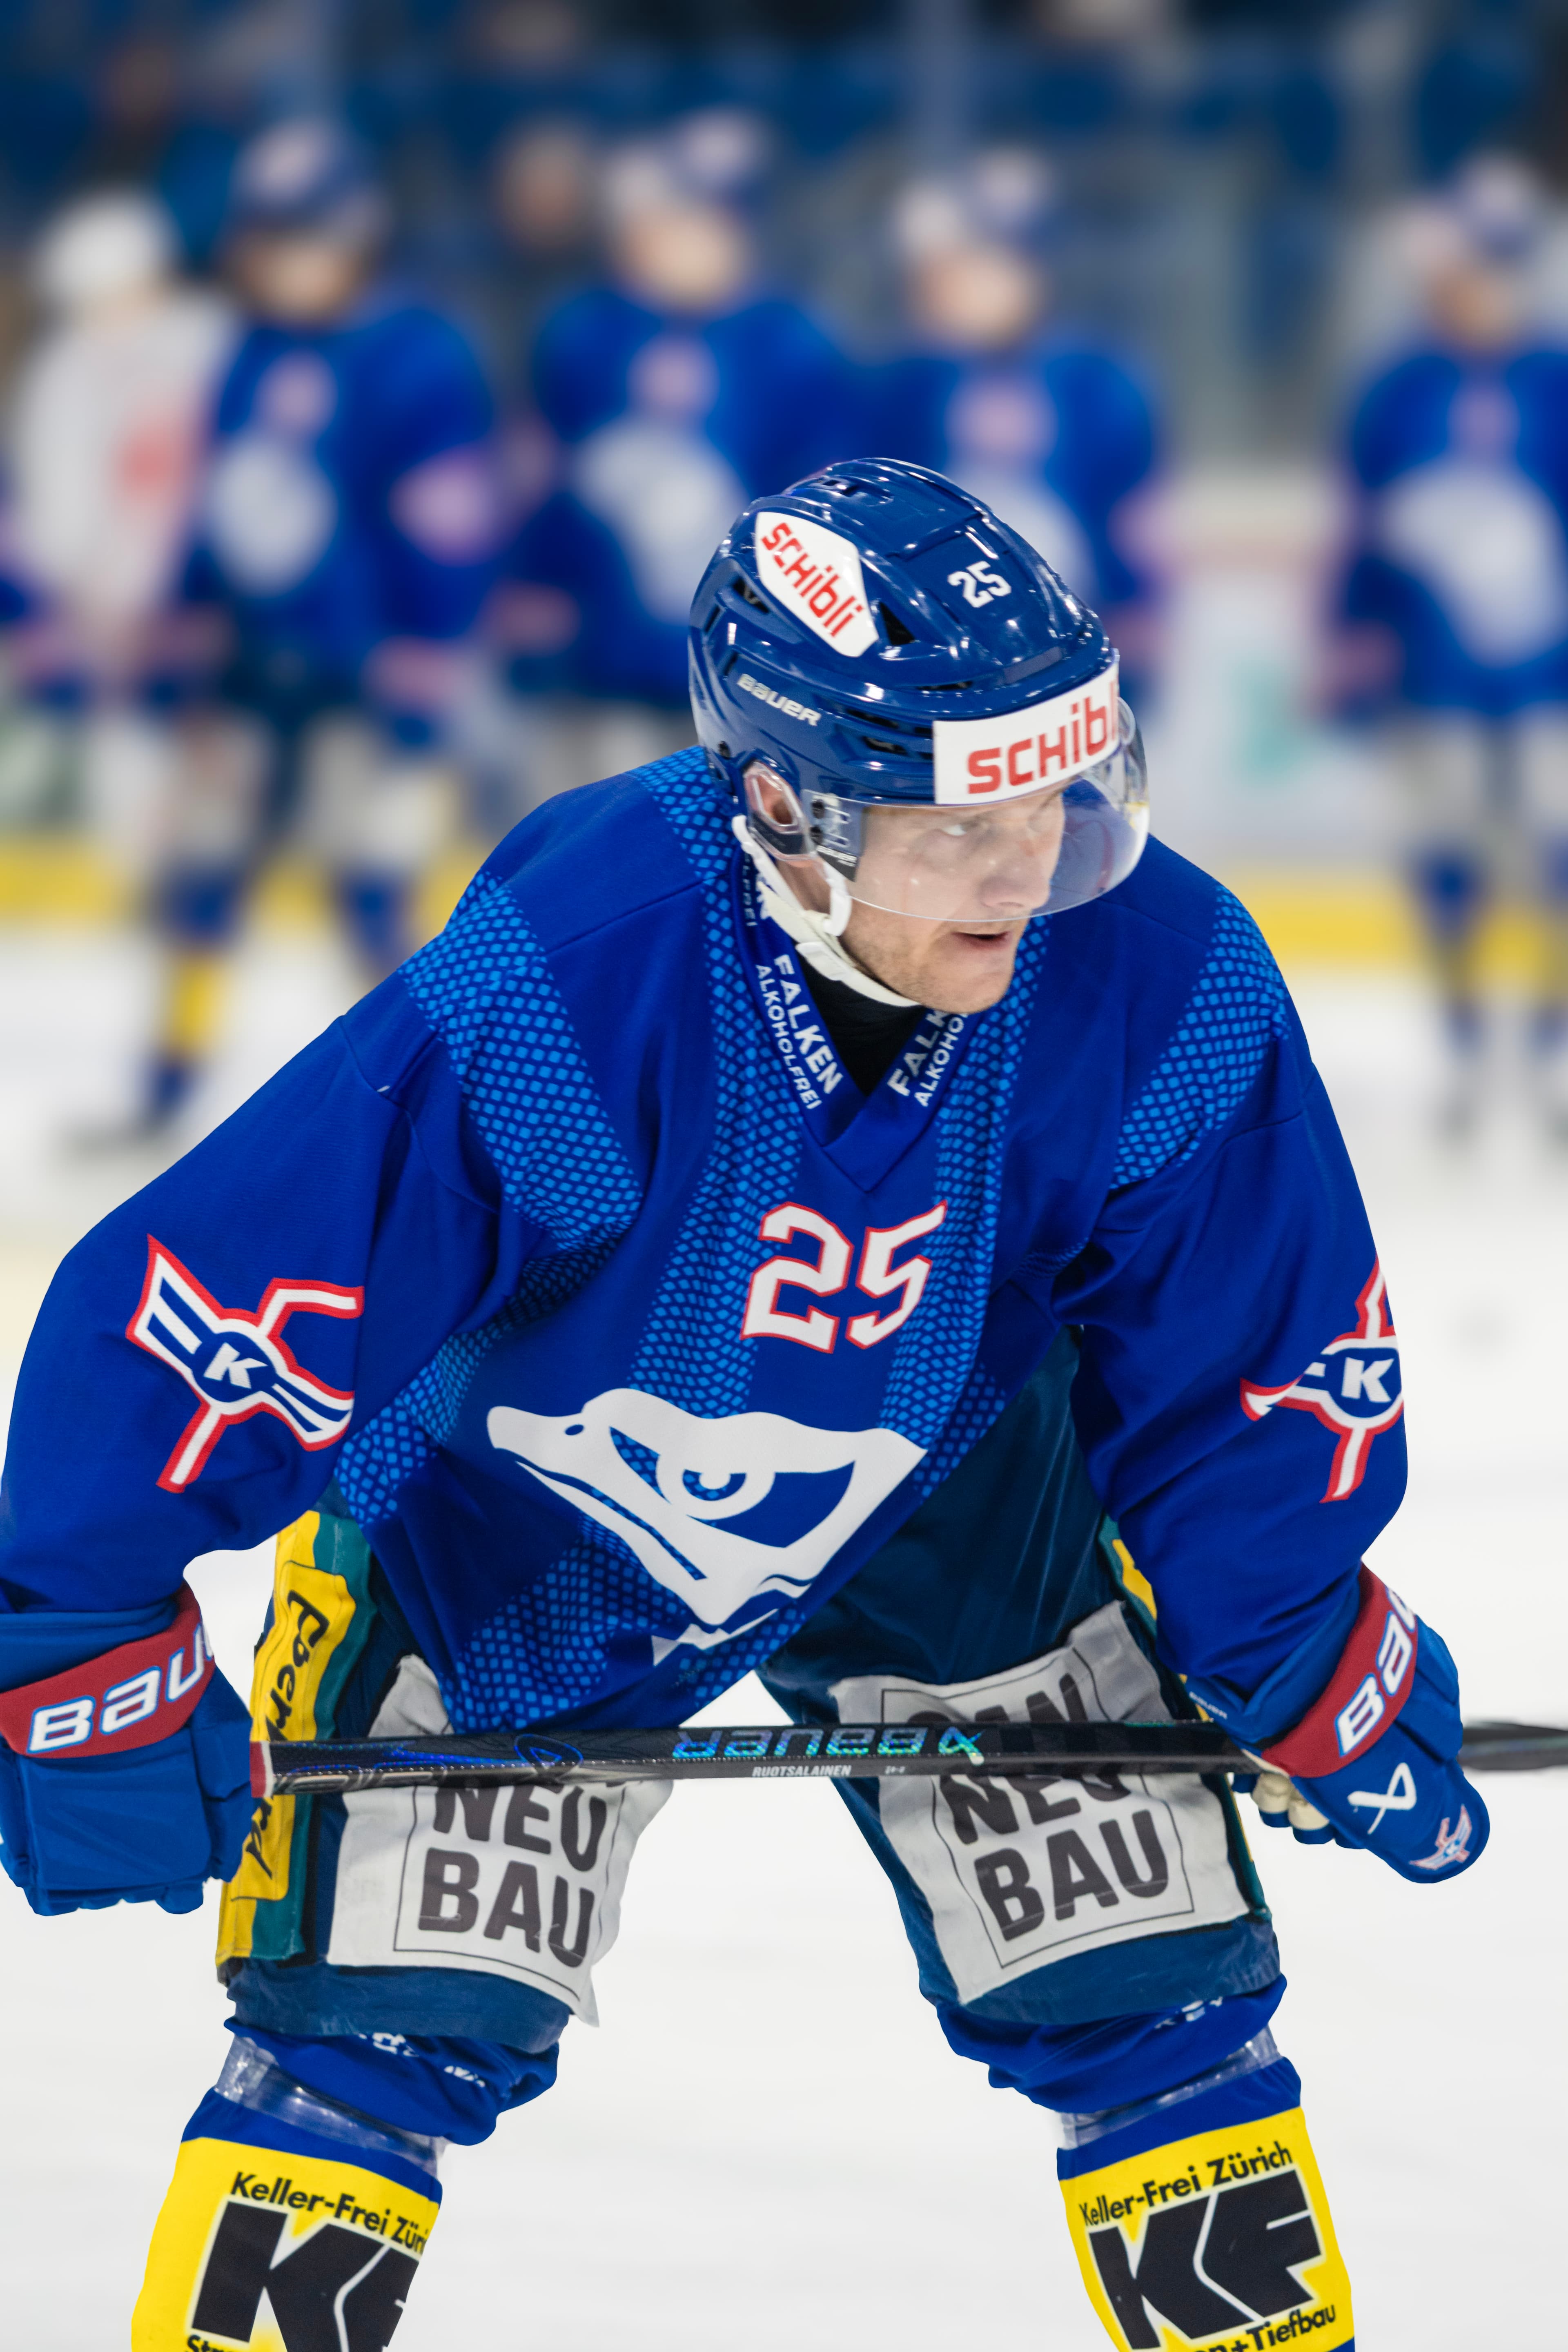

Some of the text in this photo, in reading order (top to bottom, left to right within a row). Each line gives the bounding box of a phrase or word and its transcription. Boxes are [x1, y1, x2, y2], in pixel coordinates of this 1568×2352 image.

[948, 561, 1011, 608] 25
[756, 964, 822, 1110] ALKOHOLFREI
[774, 954, 843, 1094] FALKEN
[887, 1010, 950, 1096] FALK
[914, 1013, 969, 1107] ALKOHO
[739, 1199, 948, 1354] 25
[27, 1622, 214, 1754] BAU
[751, 1764, 852, 1778] RUOTSALAINEN
[433, 1784, 607, 1872] NEU
[973, 1810, 1169, 1942] BAU
[418, 1847, 595, 1968] BAU
[230, 2171, 391, 2236] Keller-Frei
[1079, 2140, 1294, 2227] Keller-Frei Zürich
[1088, 2169, 1322, 2350] KF
